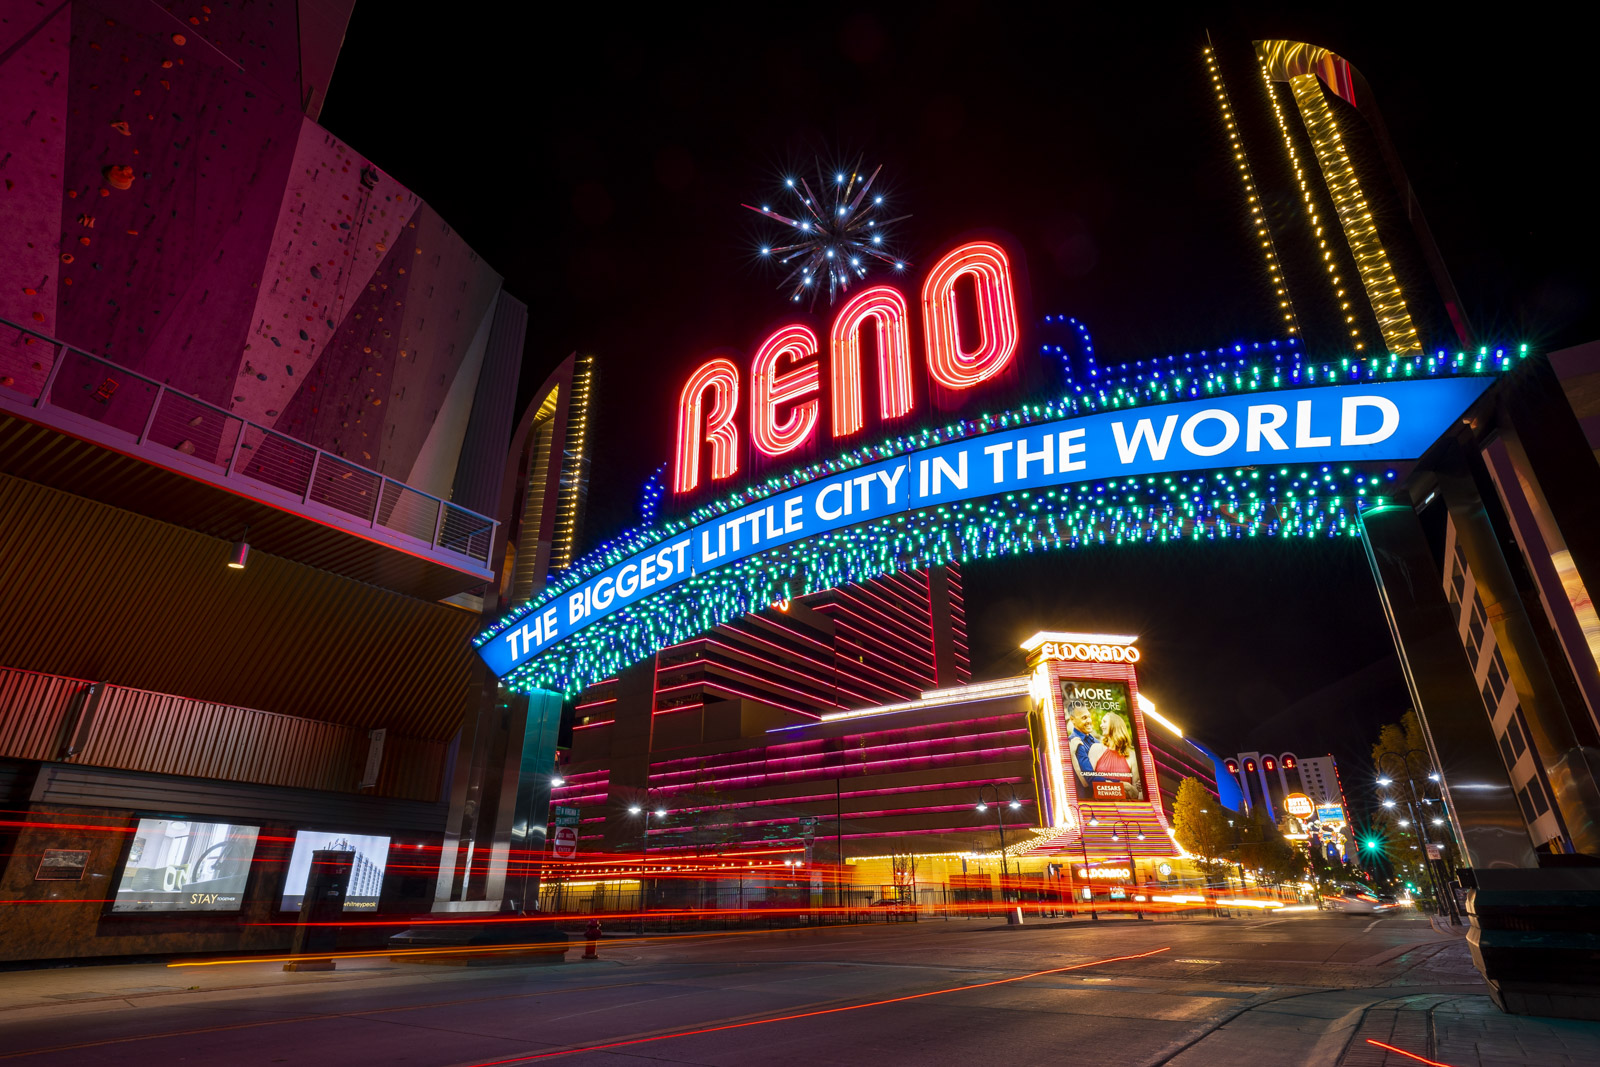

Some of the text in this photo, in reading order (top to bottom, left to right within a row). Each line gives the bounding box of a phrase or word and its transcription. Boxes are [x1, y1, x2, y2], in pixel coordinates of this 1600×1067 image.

[674, 240, 1019, 494] RENO
[506, 395, 1400, 661] THE BIGGEST LITTLE CITY IN THE WORLD
[1041, 643, 1140, 663] ELDORADO
[1074, 688, 1113, 700] MORE
[1071, 701, 1120, 710] TO EXPLORE
[190, 894, 218, 904] STAY
